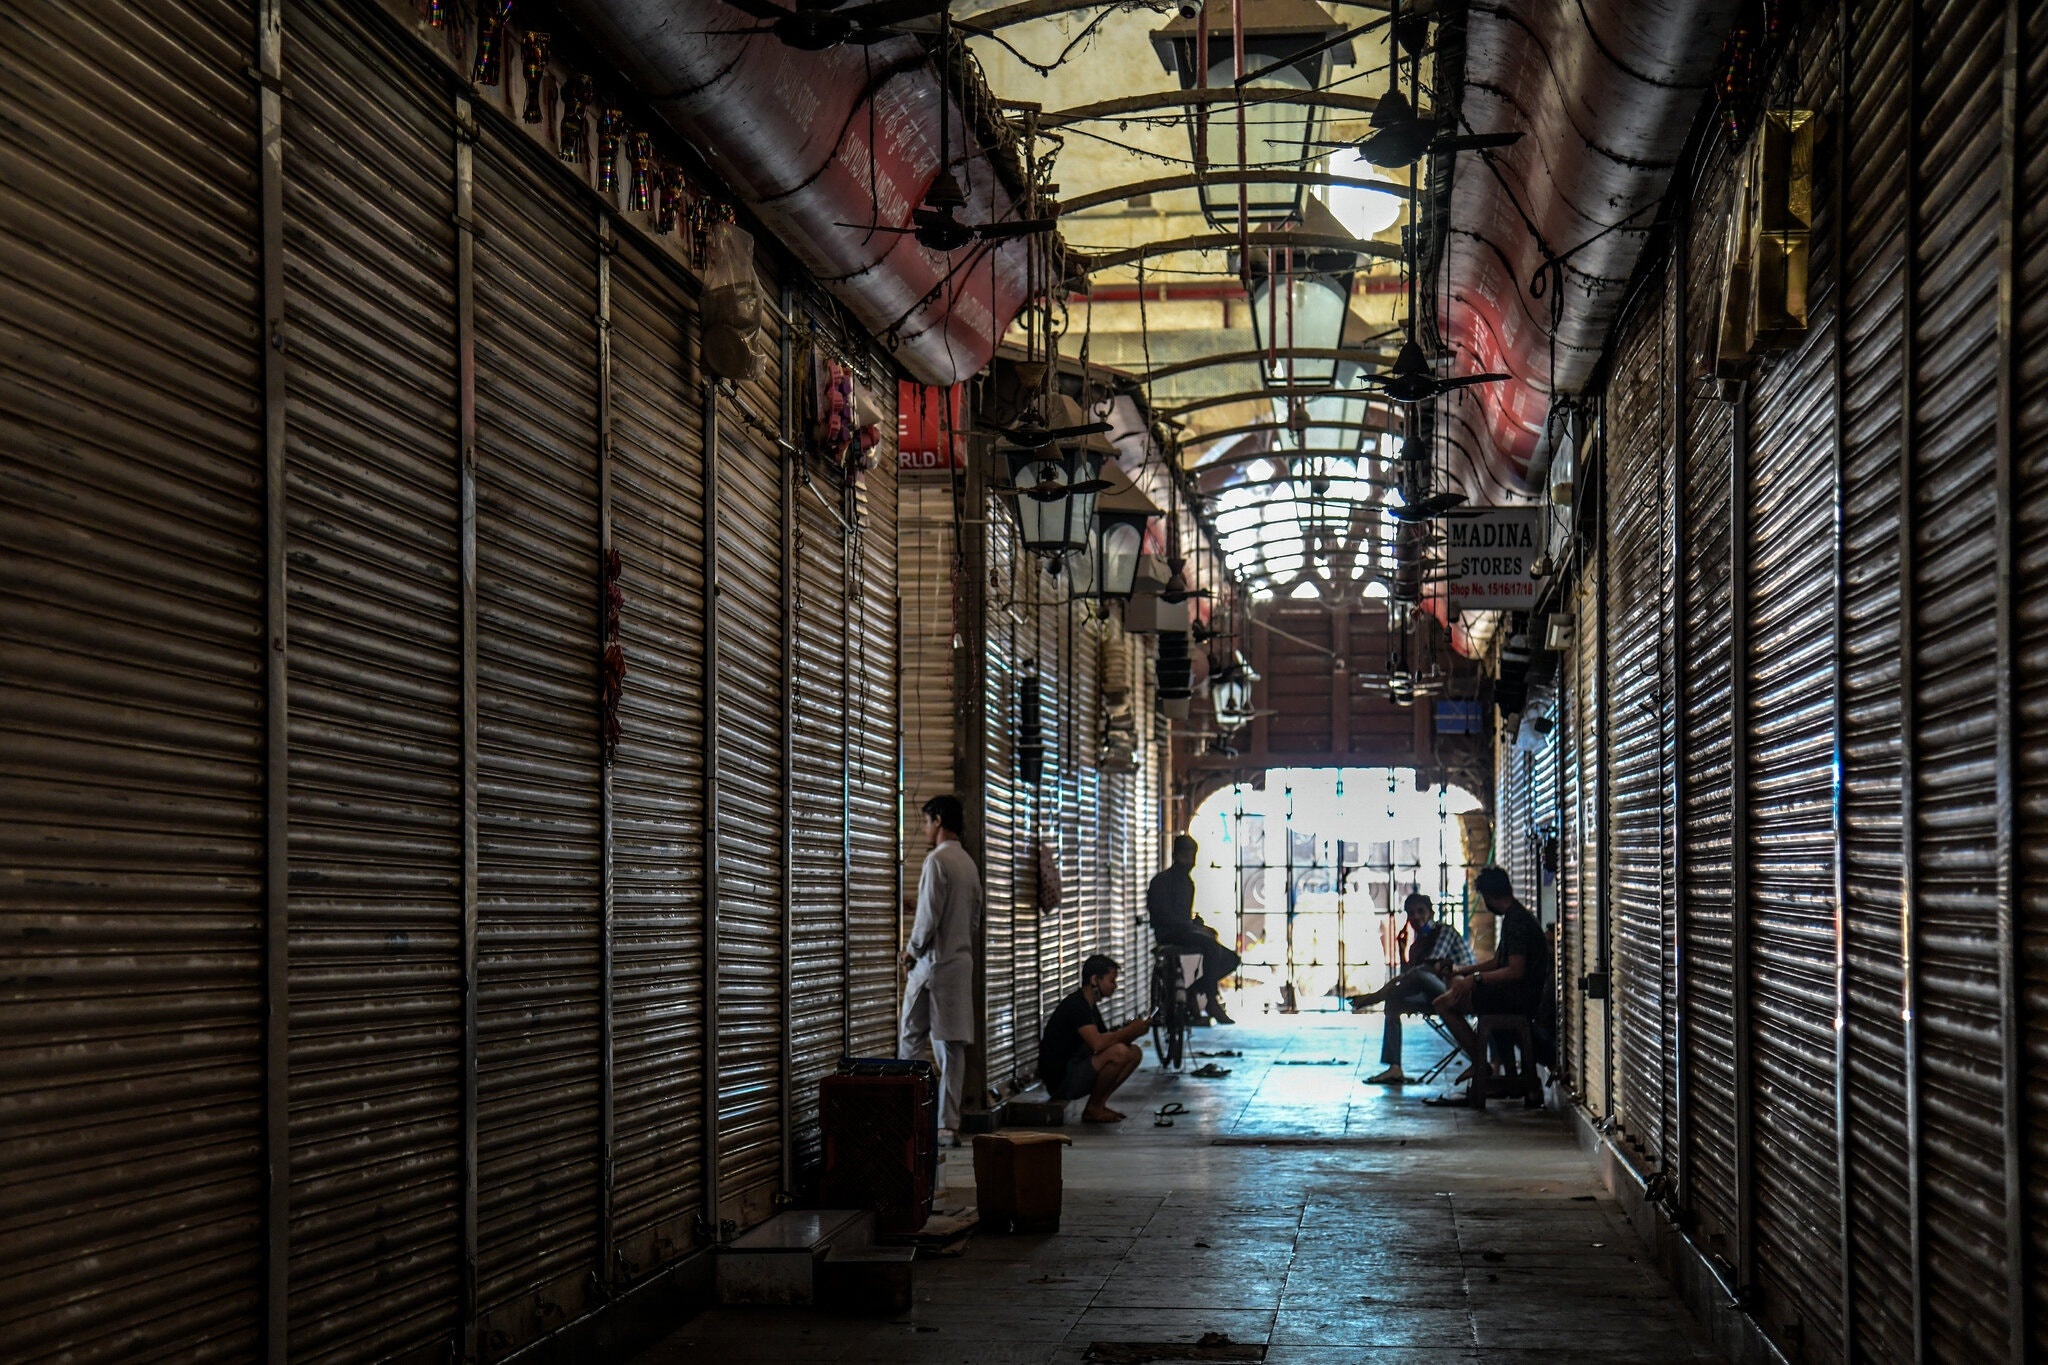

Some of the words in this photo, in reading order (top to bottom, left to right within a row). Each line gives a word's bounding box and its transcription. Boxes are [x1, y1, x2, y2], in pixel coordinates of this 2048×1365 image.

[1452, 523, 1532, 547] MADINA
[1461, 557, 1522, 575] STORES
[1450, 583, 1469, 597] Shop
[1472, 583, 1485, 595] No.
